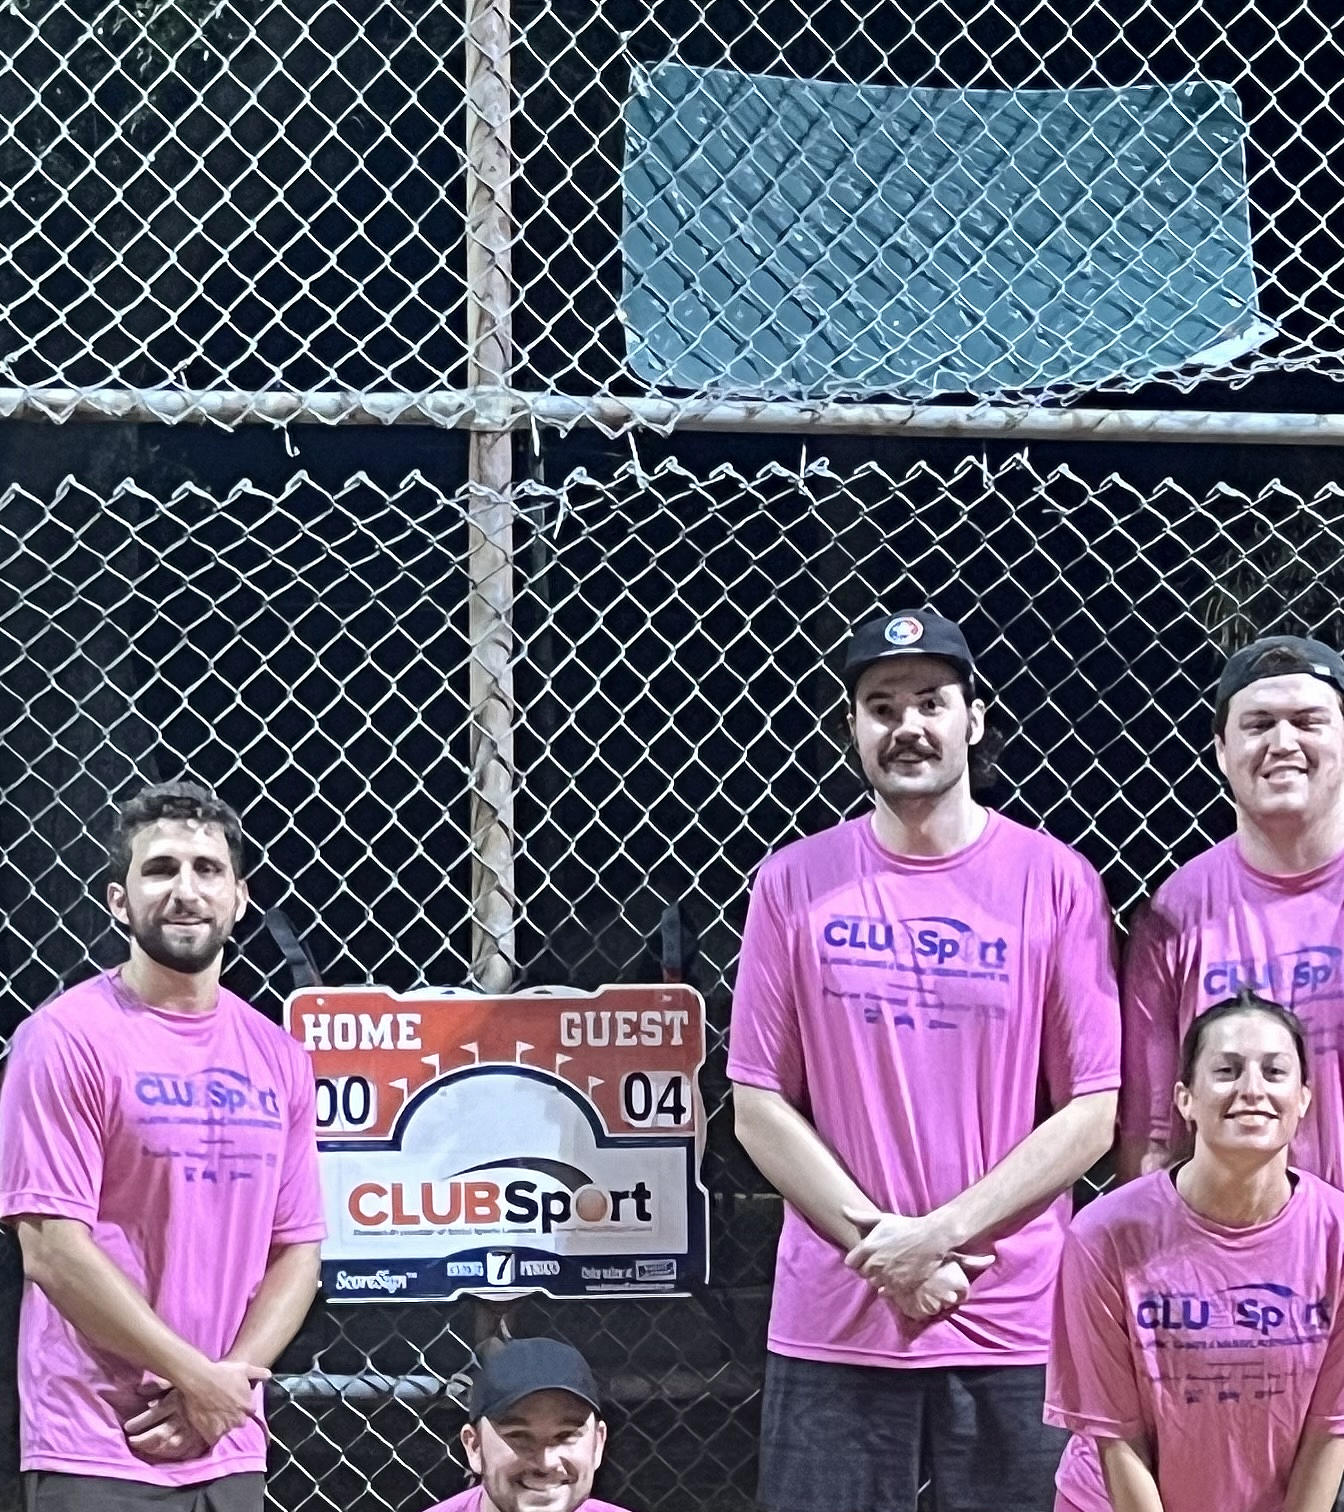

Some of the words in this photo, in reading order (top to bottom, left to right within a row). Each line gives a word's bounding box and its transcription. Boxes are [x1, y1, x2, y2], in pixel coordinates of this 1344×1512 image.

[823, 920, 1007, 965] CLUSprt
[302, 1013, 423, 1051] HOME
[560, 1010, 689, 1048] GUEST
[315, 1075, 372, 1128] 00
[623, 1071, 688, 1125] 04
[347, 1181, 653, 1234] CLUBSport
[490, 1250, 513, 1280] 7
